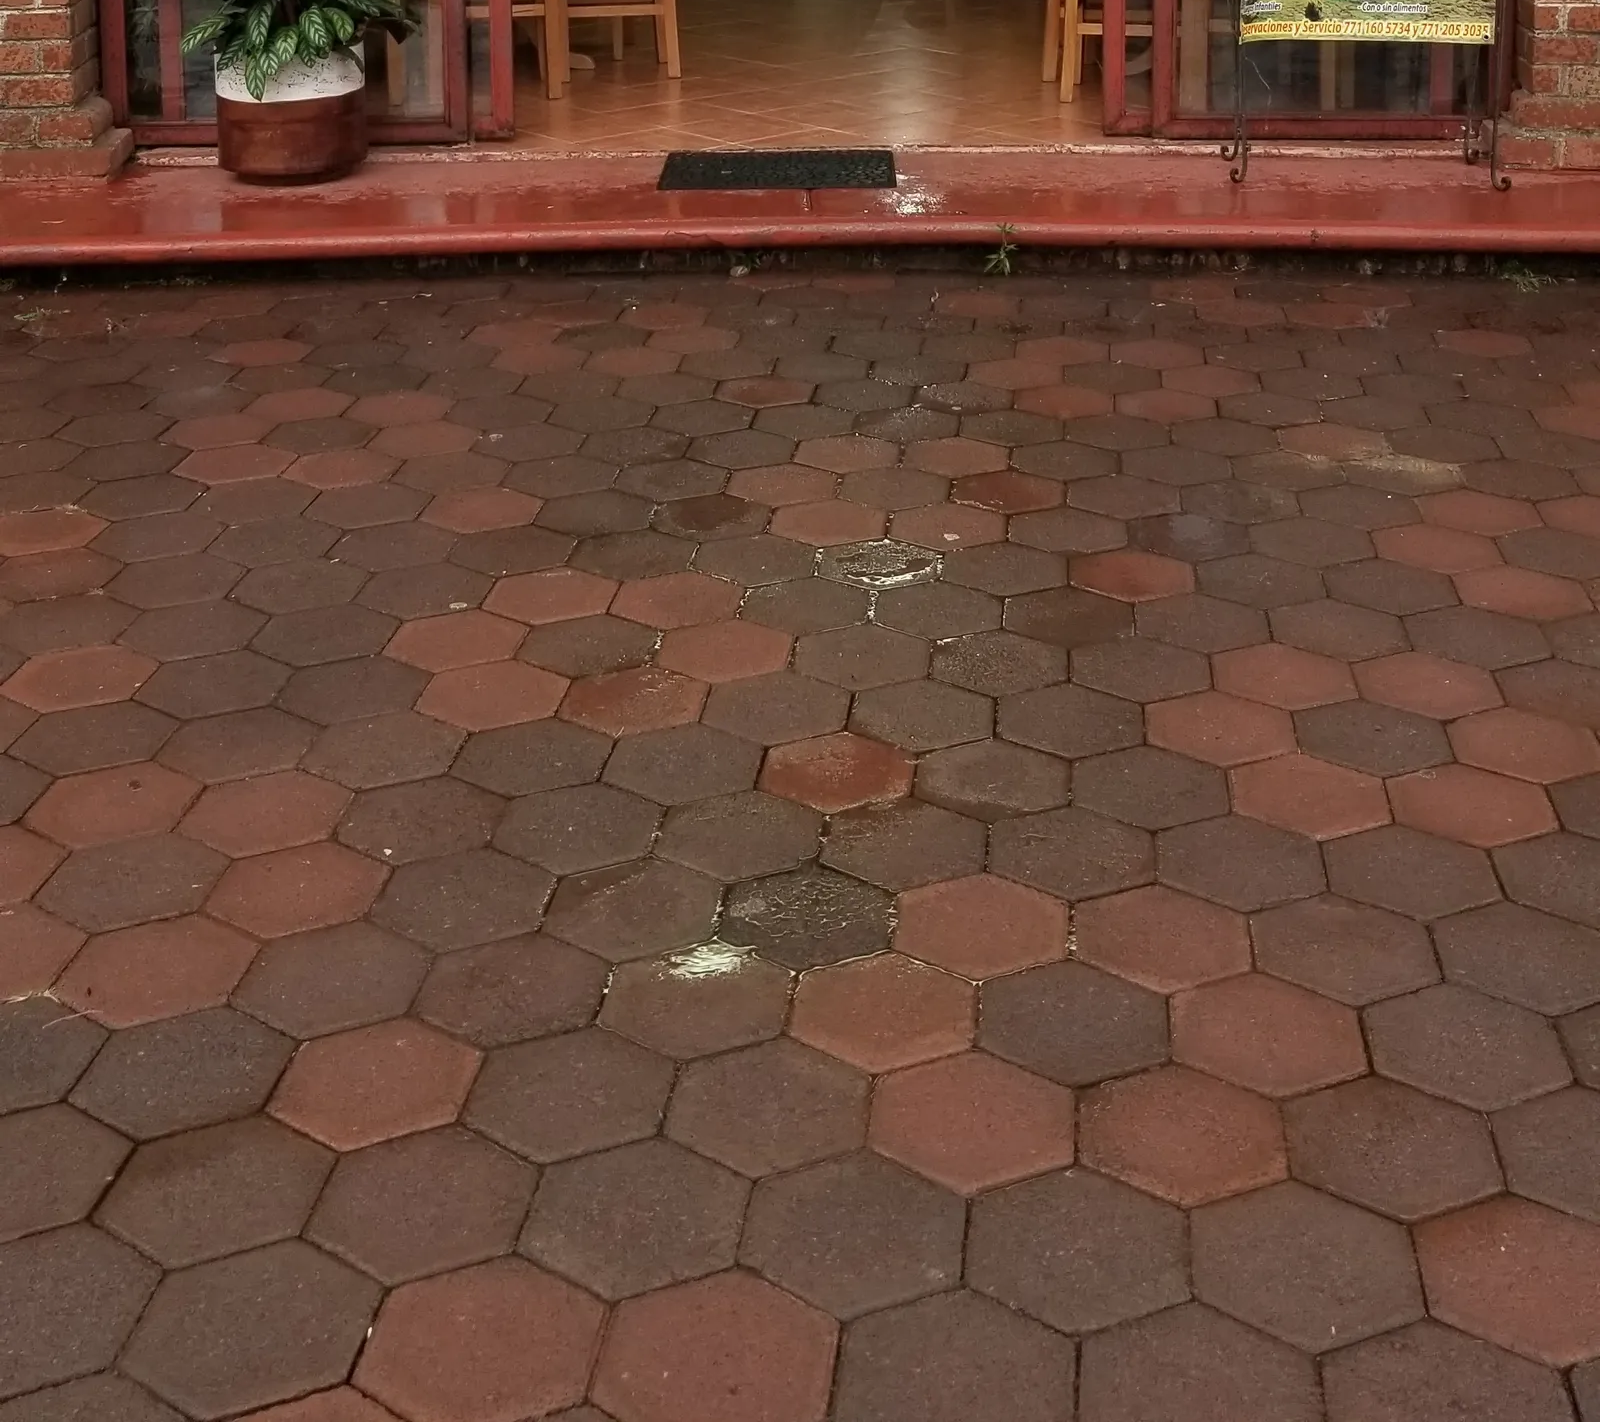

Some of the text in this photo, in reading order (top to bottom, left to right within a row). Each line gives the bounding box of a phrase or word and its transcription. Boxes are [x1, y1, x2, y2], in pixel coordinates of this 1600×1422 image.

[1361, 2, 1375, 12] Con
[1381, 2, 1391, 12] sin
[1393, 3, 1427, 13] alimentos
[1294, 23, 1301, 36] y
[1302, 20, 1342, 34] Servicio
[1344, 21, 1362, 34] 771
[1365, 22, 1384, 34] 160
[1386, 22, 1411, 35] 5734
[1412, 24, 1419, 37] y
[1421, 23, 1439, 35] 771
[1441, 24, 1461, 36] 205
